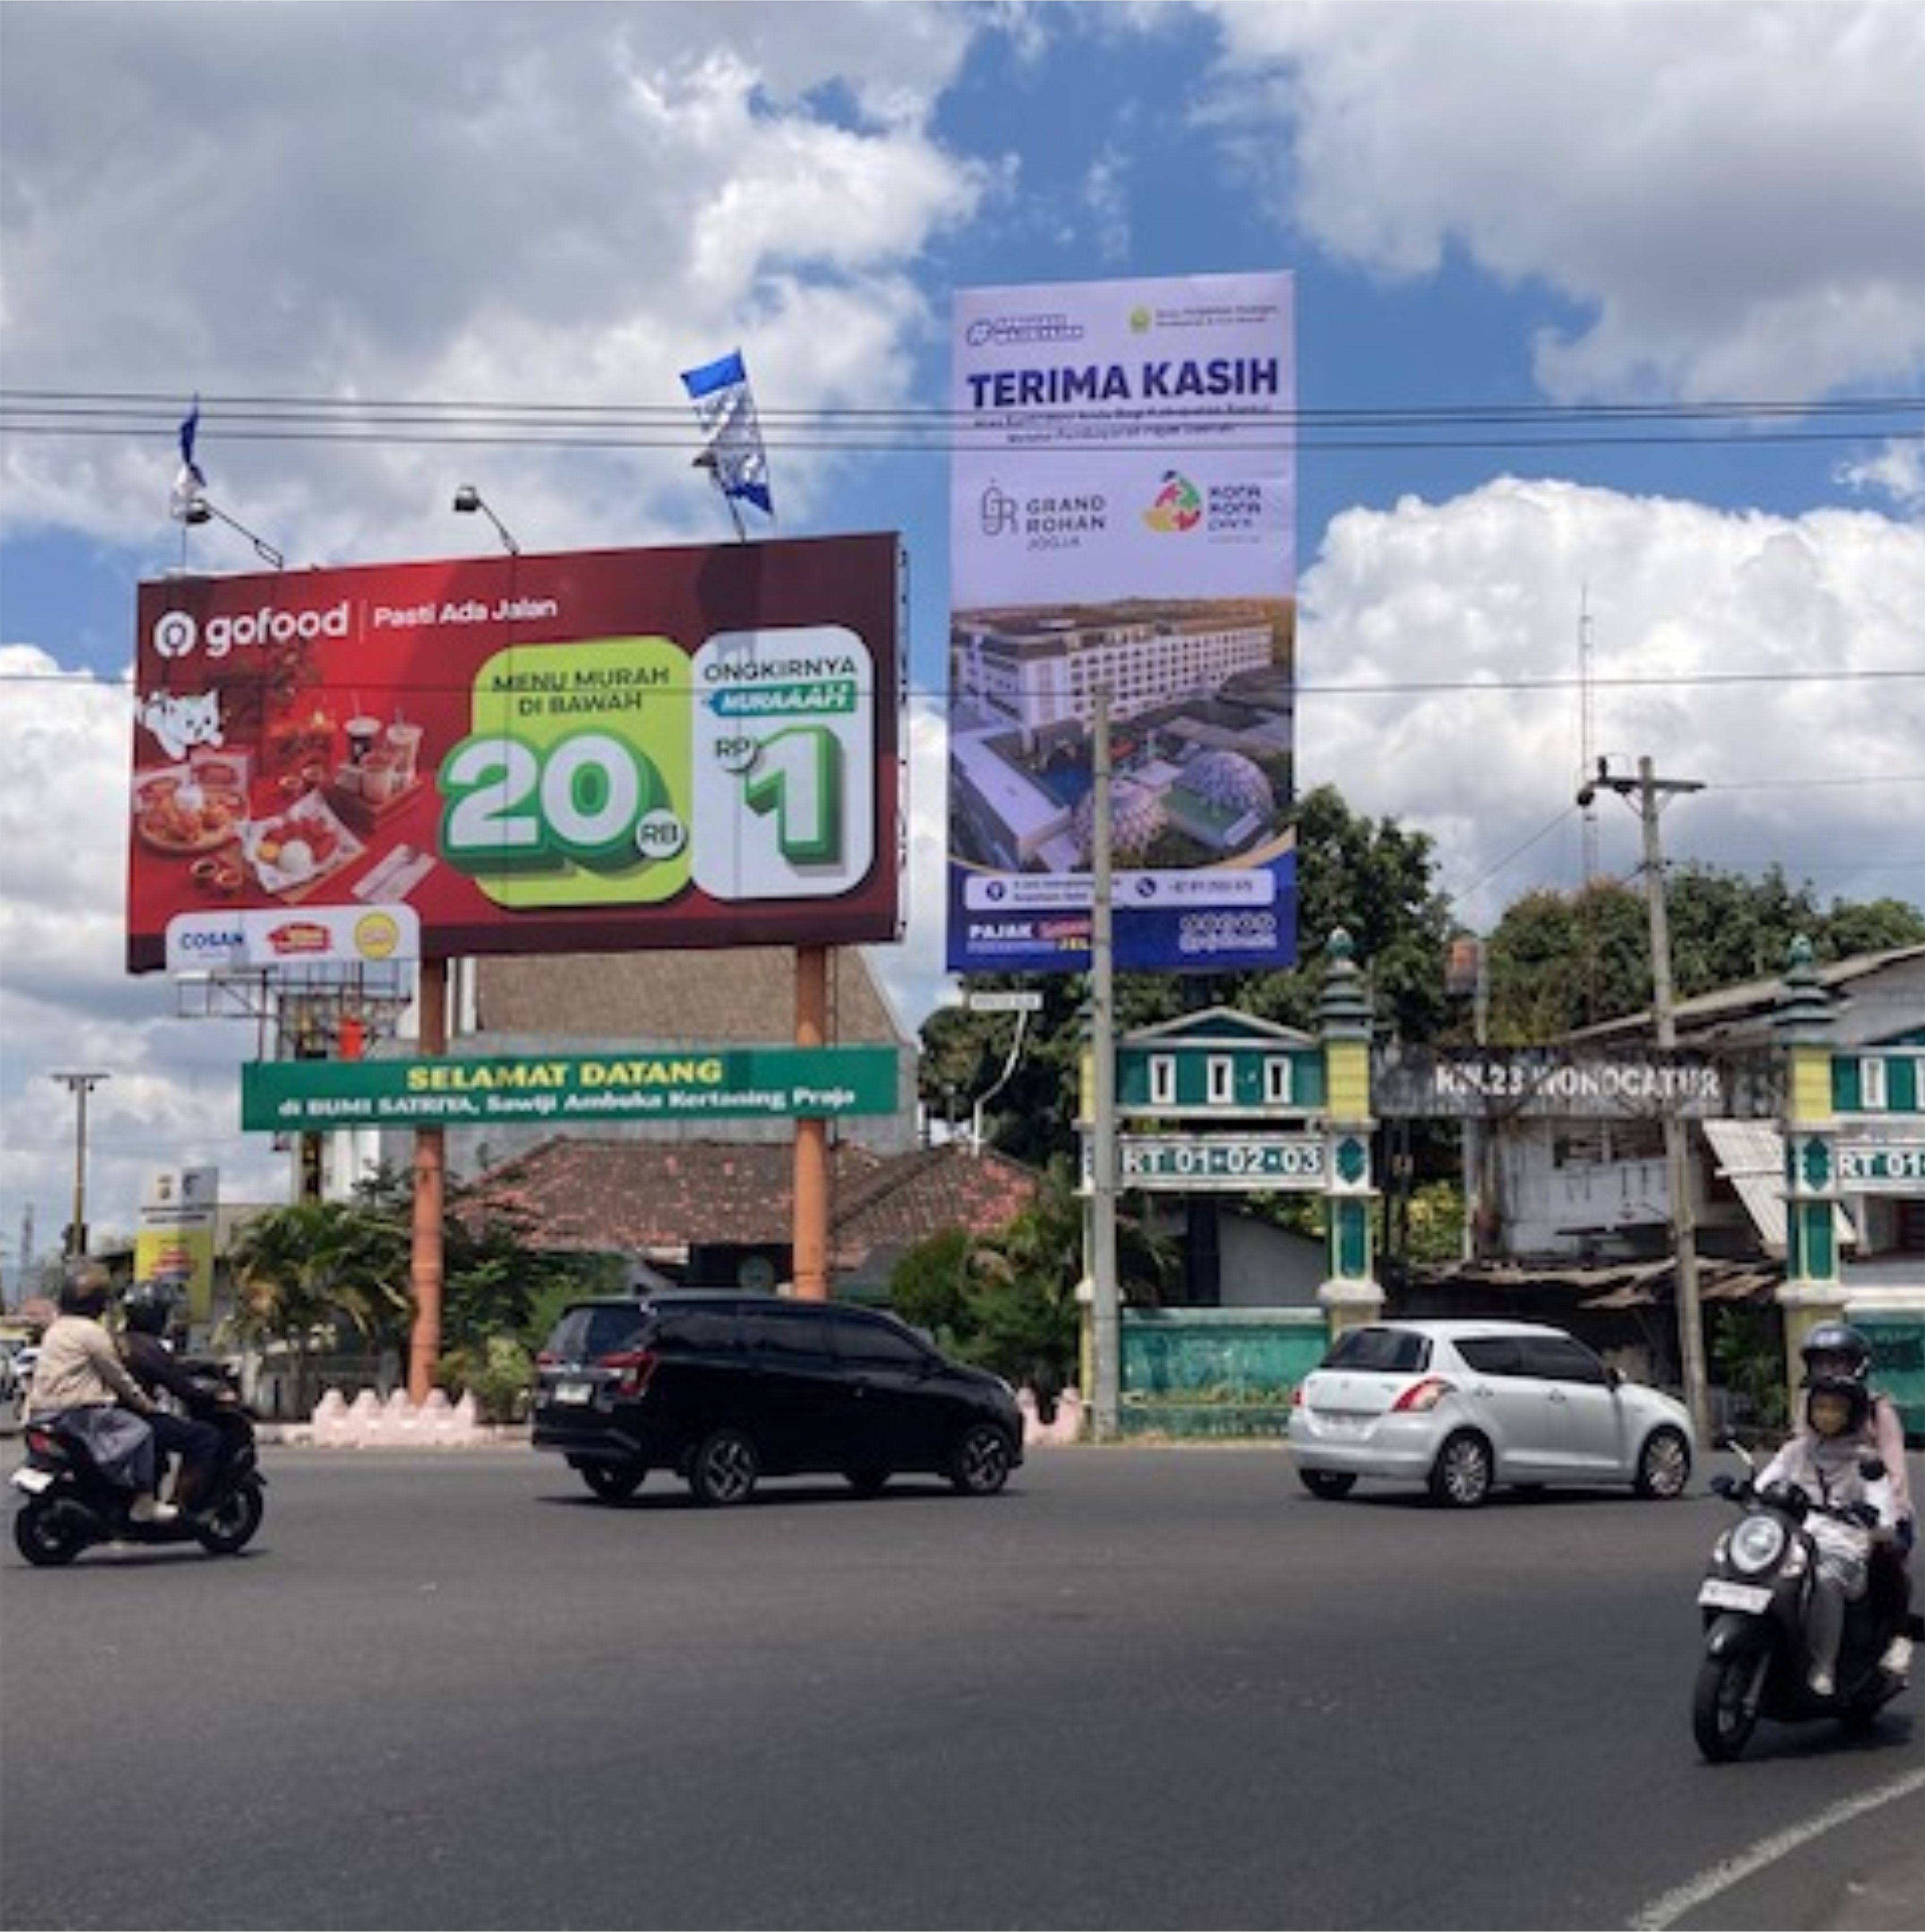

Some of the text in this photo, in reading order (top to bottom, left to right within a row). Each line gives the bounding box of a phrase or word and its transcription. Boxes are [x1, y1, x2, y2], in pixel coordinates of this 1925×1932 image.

[967, 357, 1277, 409] TERIMA KASIH
[1026, 495, 1105, 515] GRAND
[1026, 515, 1105, 534] ROHAN
[375, 598, 557, 628] Pasti Ada Jalan
[205, 601, 349, 658] gofood
[493, 667, 669, 692] MENU MURAH
[704, 657, 857, 681] ONGKIRNYA
[520, 692, 641, 716] DI BAWAH
[442, 730, 647, 858] 20
[715, 726, 834, 853] RP 1
[969, 923, 1032, 939] PAJAK
[407, 1060, 723, 1091] SELAMAT DATANG
[278, 1099, 300, 1116] di
[307, 1098, 372, 1116] BUMI
[564, 1090, 662, 1111] Ambuka
[669, 1088, 786, 1110] Kertaning
[793, 1087, 855, 1108] Praja
[1122, 1146, 1165, 1173] RT
[1838, 1151, 1876, 1176] RT
